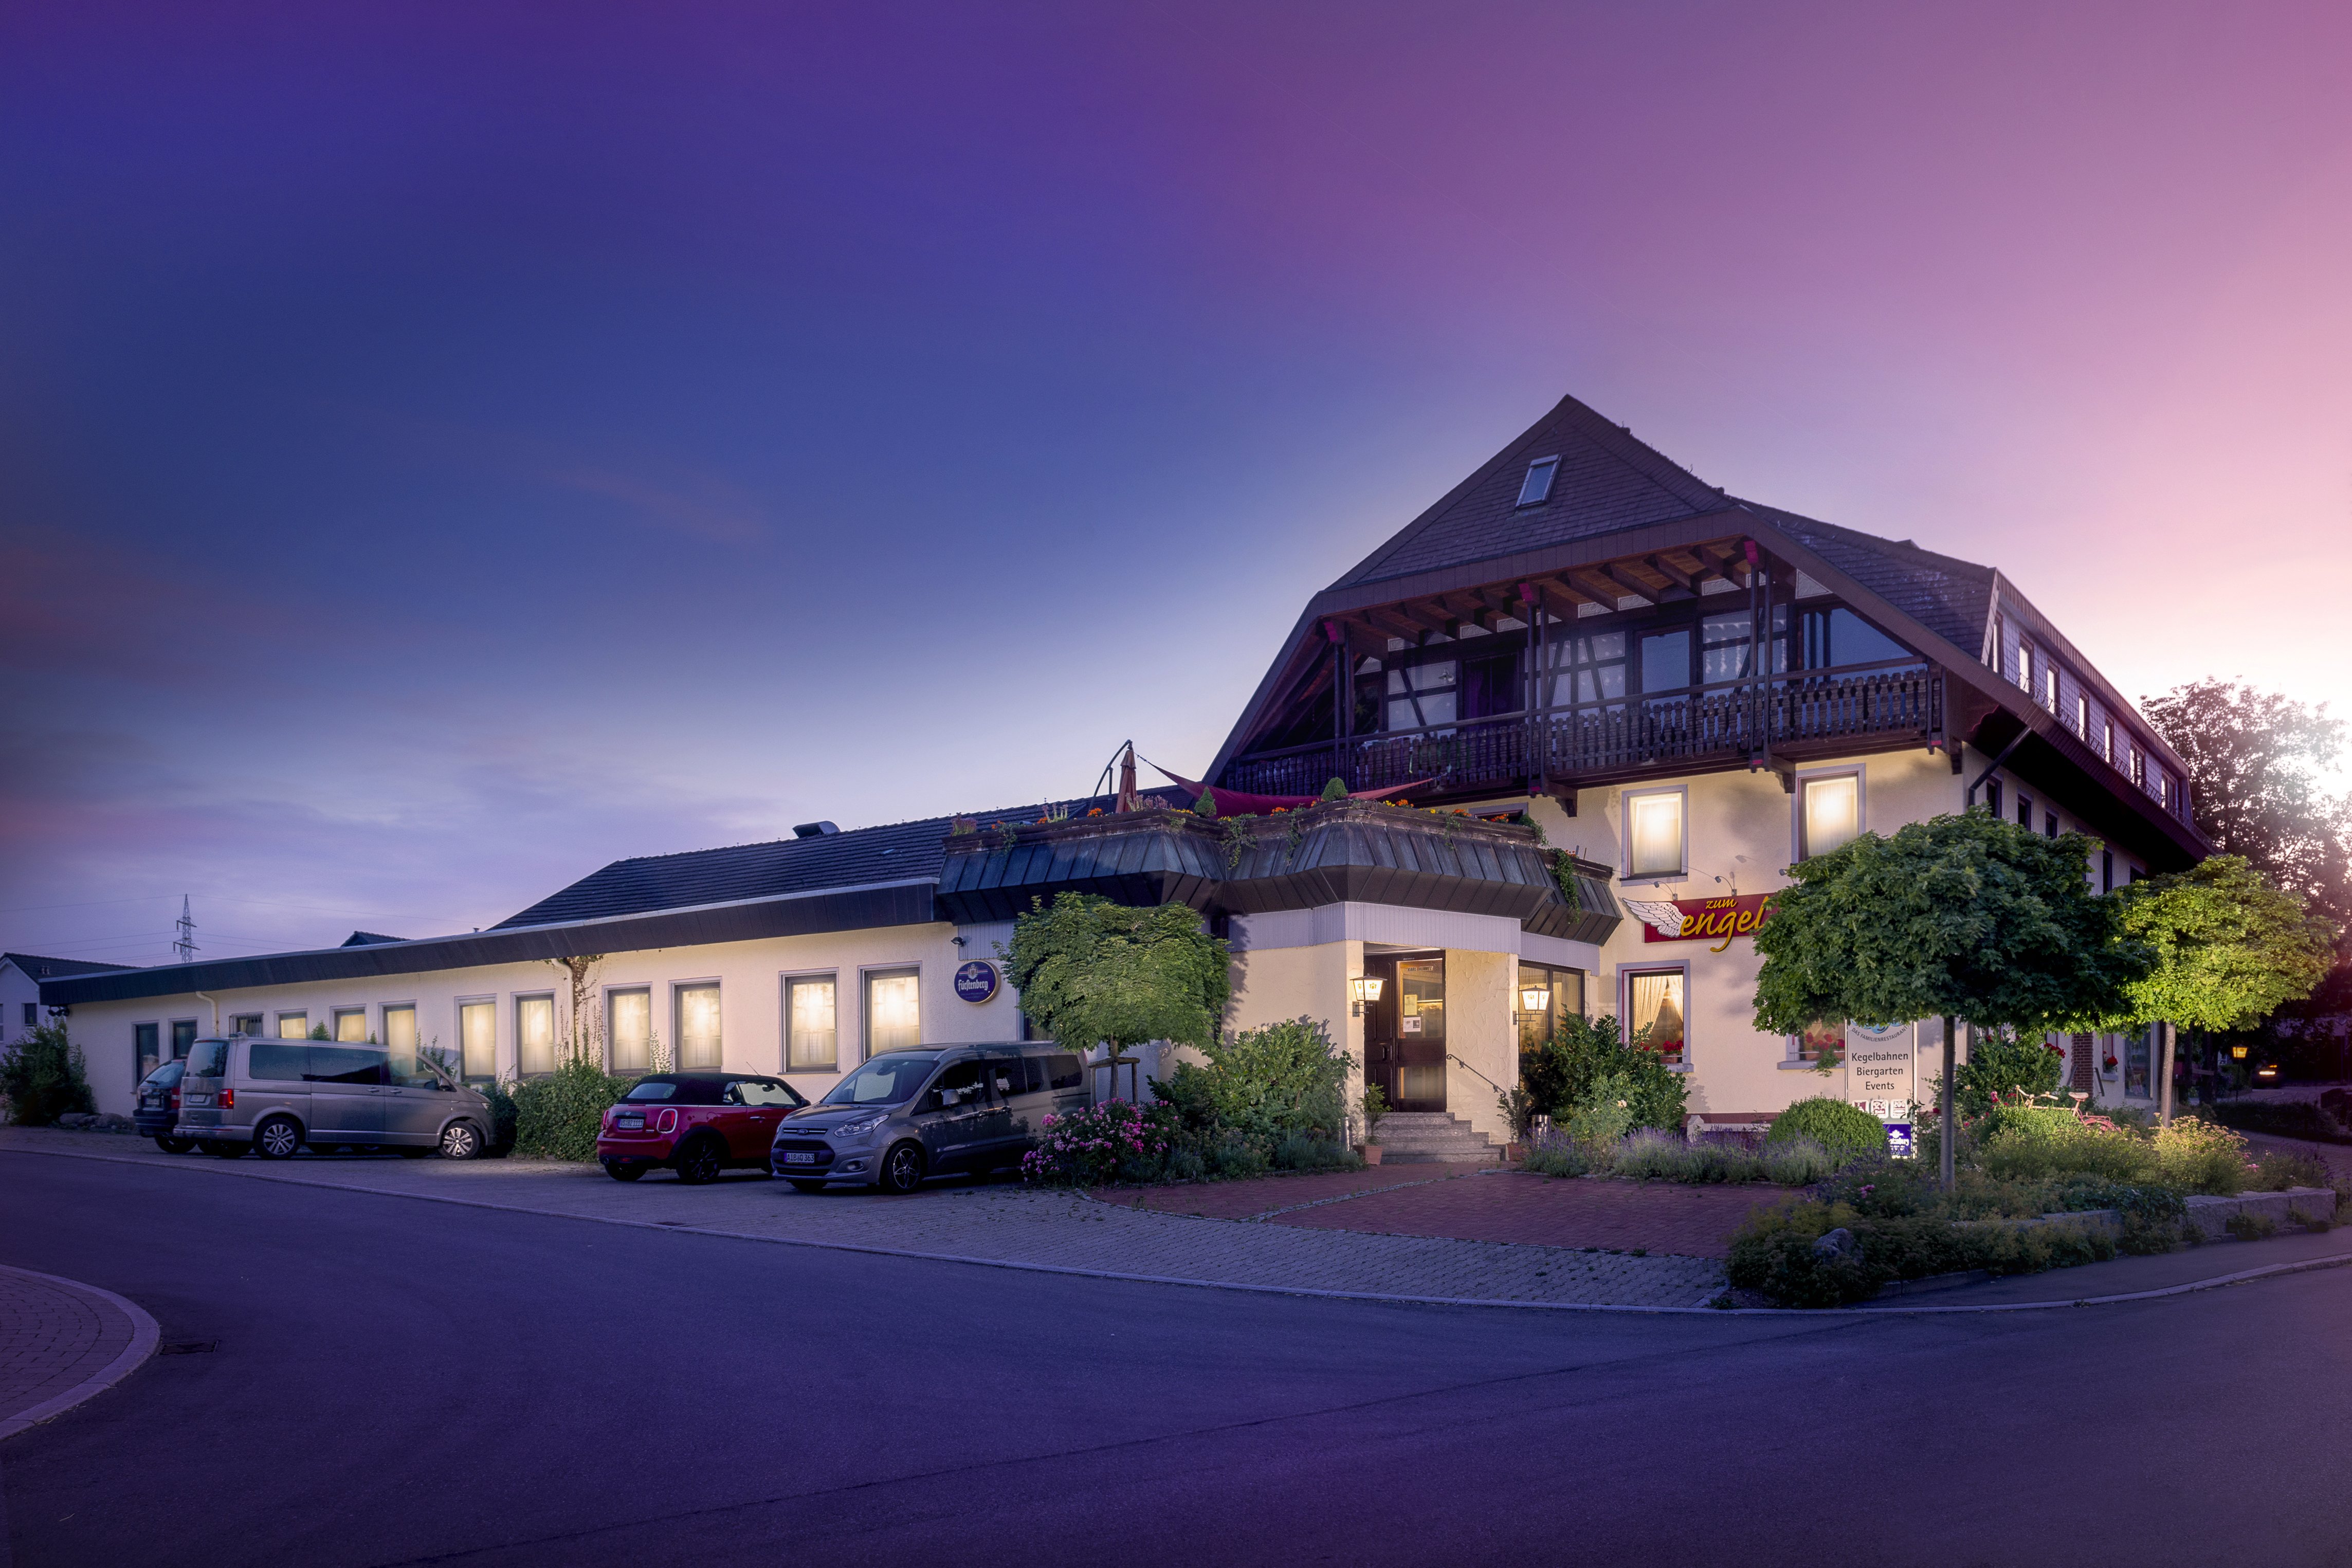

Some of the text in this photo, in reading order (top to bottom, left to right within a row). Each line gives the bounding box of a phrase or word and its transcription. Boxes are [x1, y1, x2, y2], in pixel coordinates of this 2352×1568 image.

[1705, 899, 1737, 909] zum
[1680, 896, 1768, 953] engel
[1851, 1027, 1859, 1036] DAS
[1852, 1052, 1908, 1064] Kegelbahnen
[1857, 1067, 1903, 1078] Biergarten
[1866, 1081, 1894, 1090] Events
